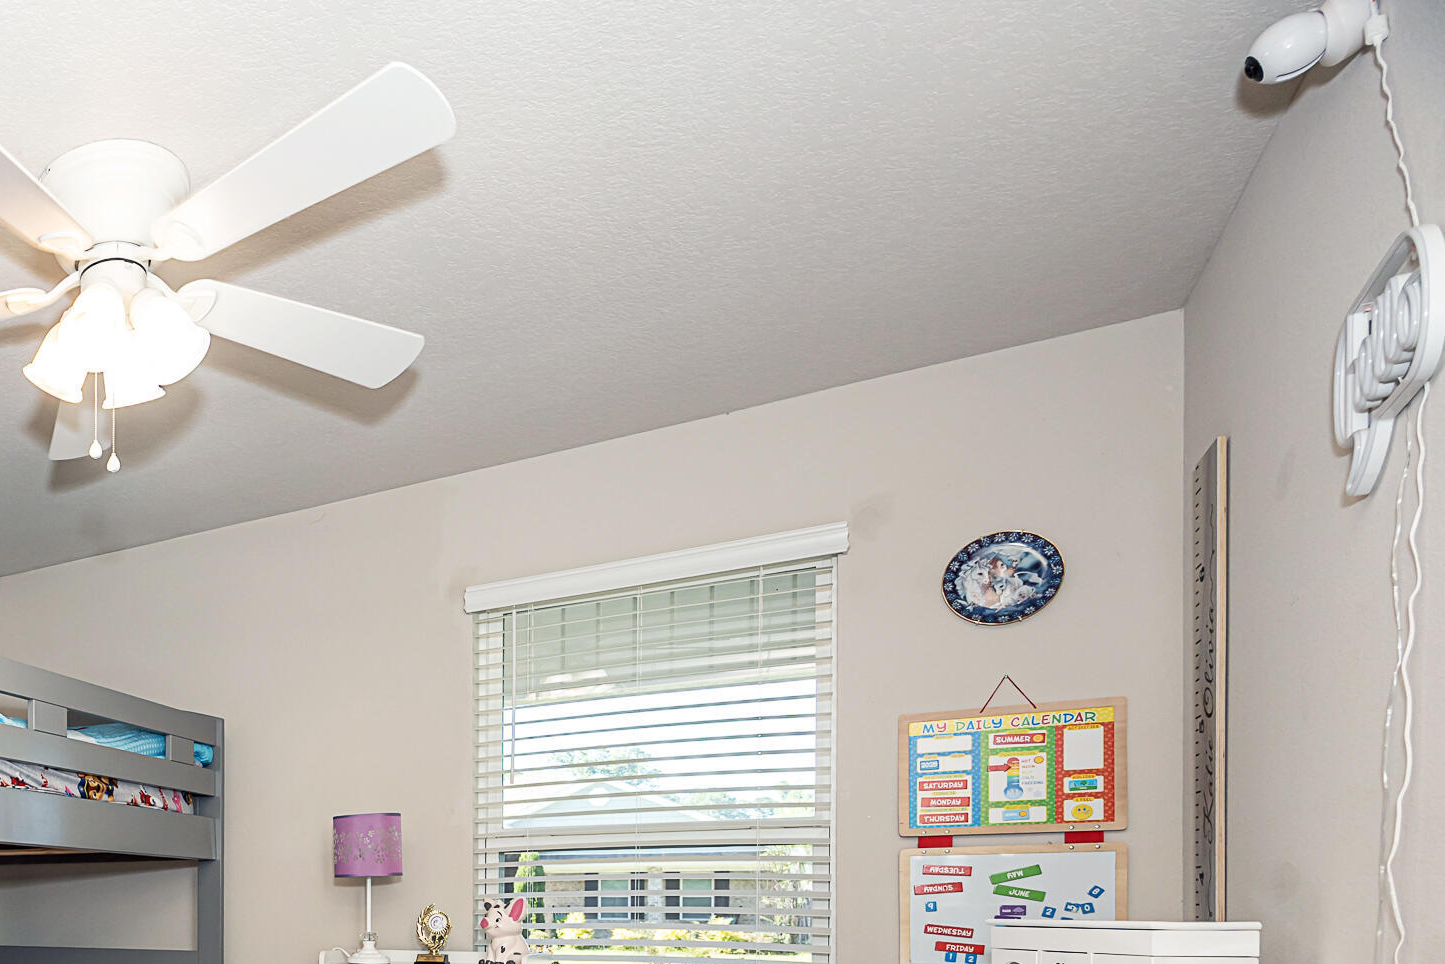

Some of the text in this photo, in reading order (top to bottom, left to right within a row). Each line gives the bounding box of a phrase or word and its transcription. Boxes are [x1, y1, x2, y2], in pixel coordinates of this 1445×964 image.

[922, 711, 1097, 734] MY DAILY CALENDAR
[995, 734, 1031, 744] SUMMER
[922, 781, 964, 789] SATURDAY
[929, 798, 961, 806] MONDAY
[923, 814, 965, 823] THURSDAY
[929, 866, 966, 874] TUESDAY
[1006, 870, 1024, 879] MAY
[923, 885, 954, 893] SUNDAY
[1008, 889, 1031, 898] JUNE
[927, 902, 934, 910] 9
[1045, 908, 1053, 916] 2
[926, 925, 972, 937] WEDNESDAY
[945, 944, 975, 952] FRIDAY
[967, 955, 974, 963] 2
